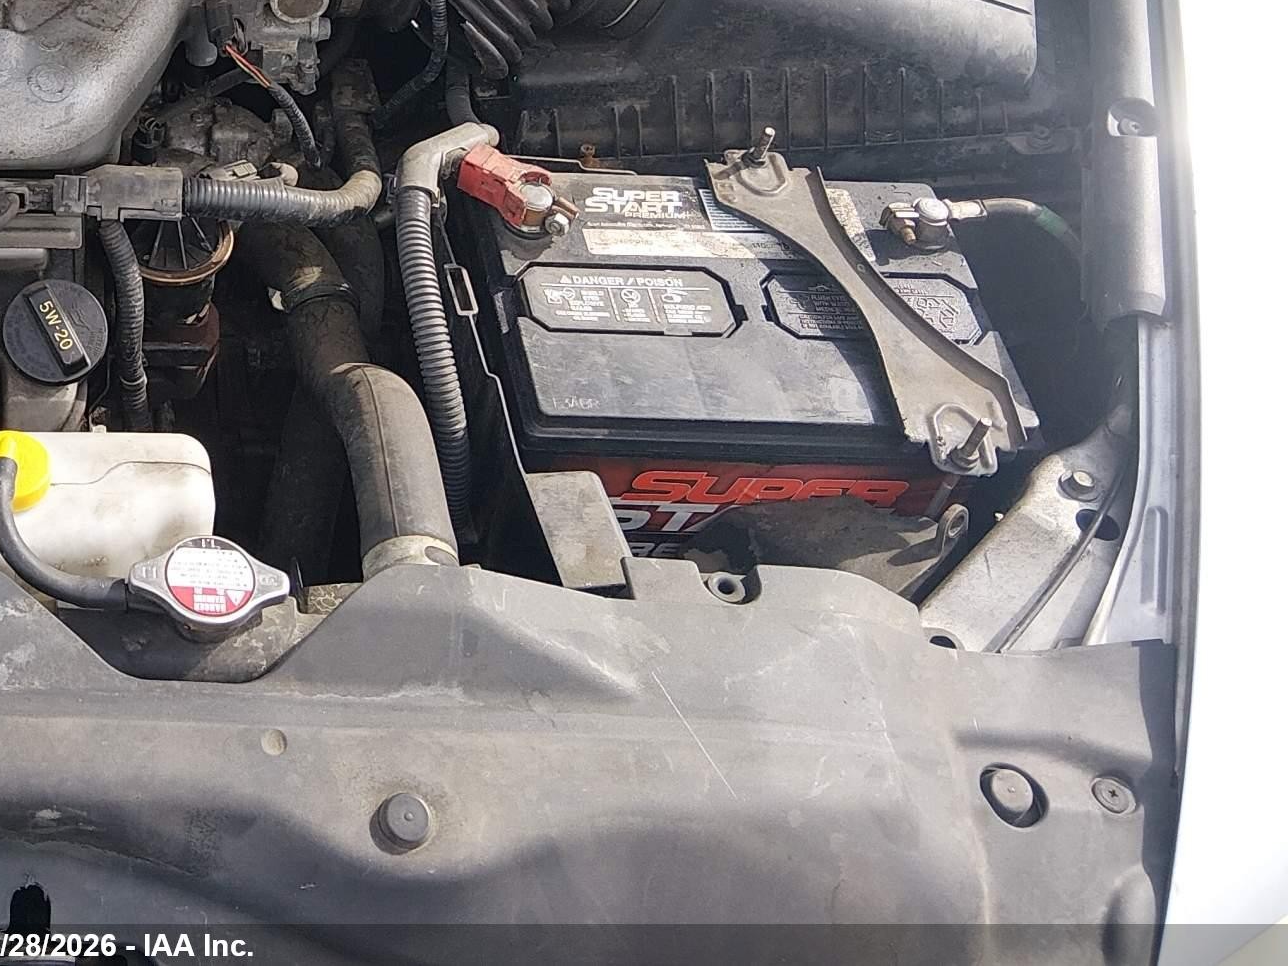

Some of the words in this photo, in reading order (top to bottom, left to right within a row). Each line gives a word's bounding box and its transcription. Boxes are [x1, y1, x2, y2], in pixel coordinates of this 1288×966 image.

[592, 186, 681, 202] SUPER
[584, 198, 683, 213] START
[572, 276, 624, 286] DANGER
[637, 278, 684, 288] POISON
[39, 300, 73, 351] 5W-20
[620, 471, 910, 506] SUPER
